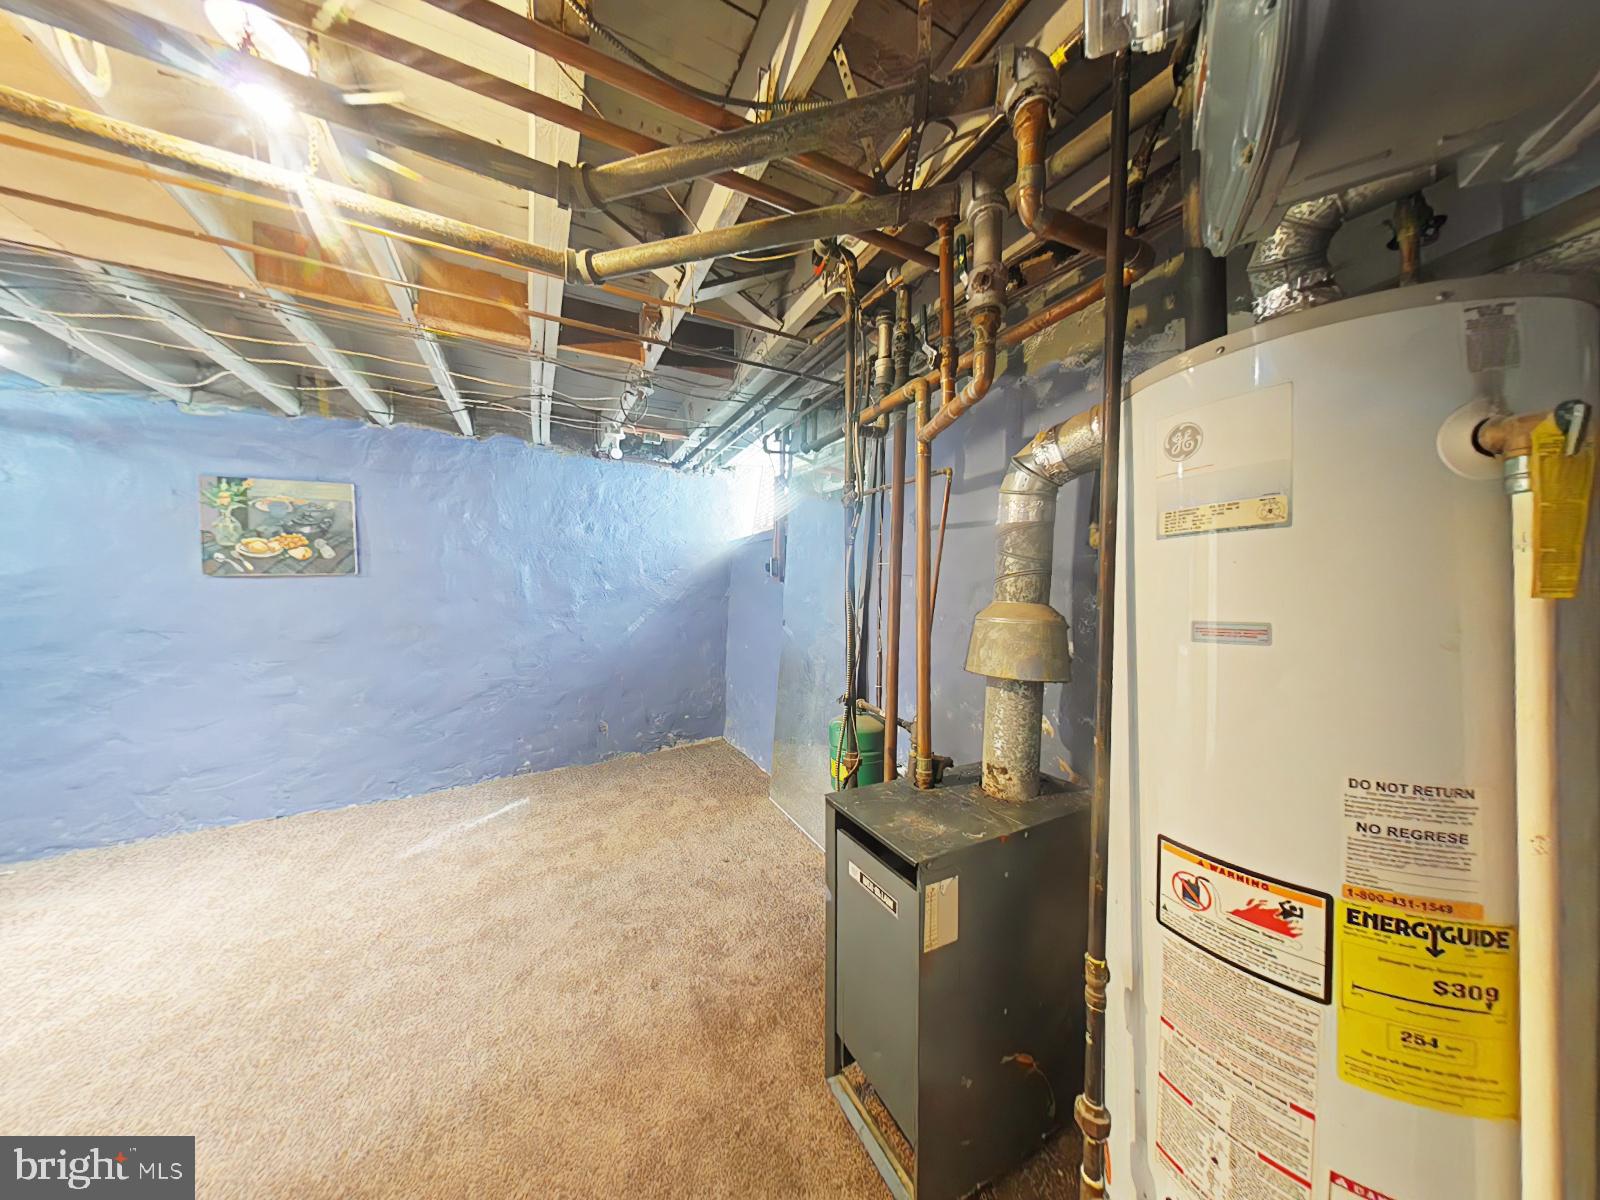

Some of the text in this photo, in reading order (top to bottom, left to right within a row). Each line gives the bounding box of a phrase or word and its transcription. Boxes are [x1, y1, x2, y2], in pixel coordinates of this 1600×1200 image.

[1348, 778, 1476, 800] DO NOT RETURN
[1356, 821, 1470, 845] NO REGRESE
[1209, 863, 1270, 891] WARNING
[1400, 1031, 1439, 1049] 254
